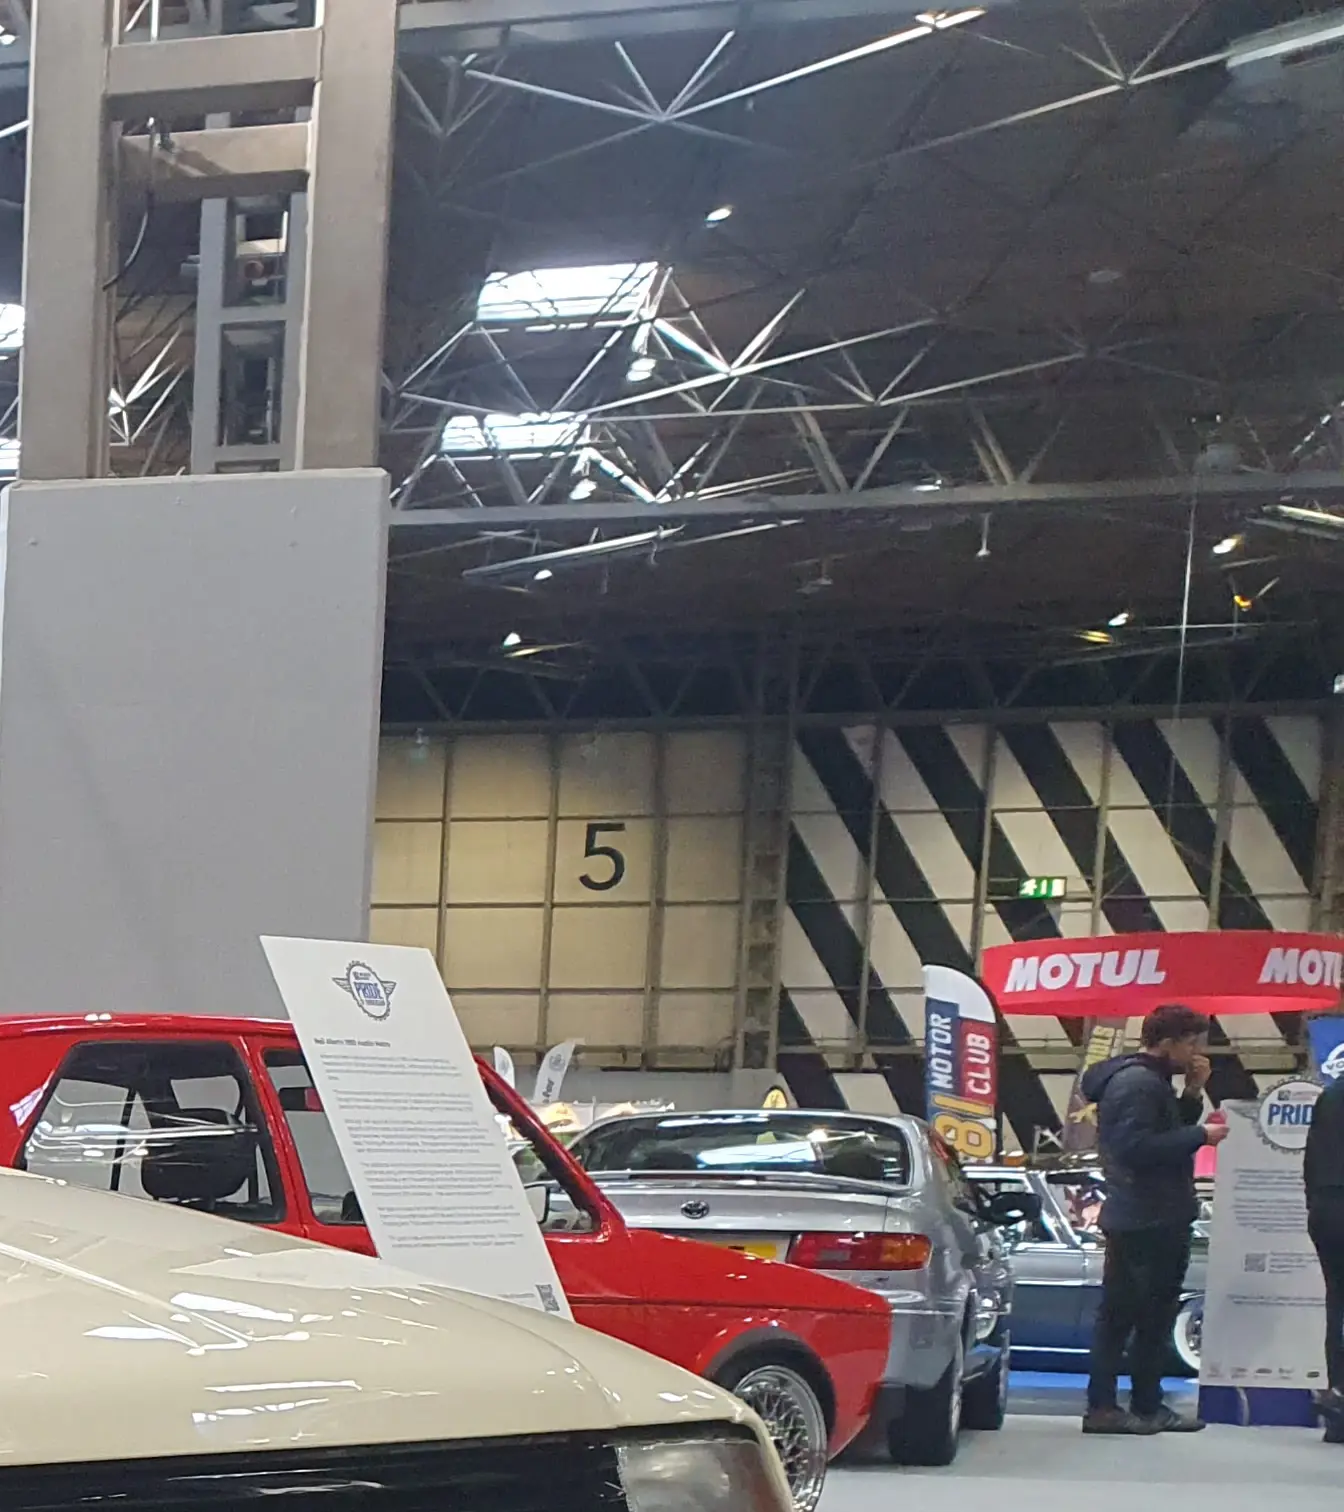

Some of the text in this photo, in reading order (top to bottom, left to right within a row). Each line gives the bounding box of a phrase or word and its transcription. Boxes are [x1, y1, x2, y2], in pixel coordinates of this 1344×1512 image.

[579, 823, 625, 891] 5
[1004, 949, 1165, 993] MOTUL
[929, 1011, 954, 1090] MOTOR
[966, 1032, 992, 1095] CLUB
